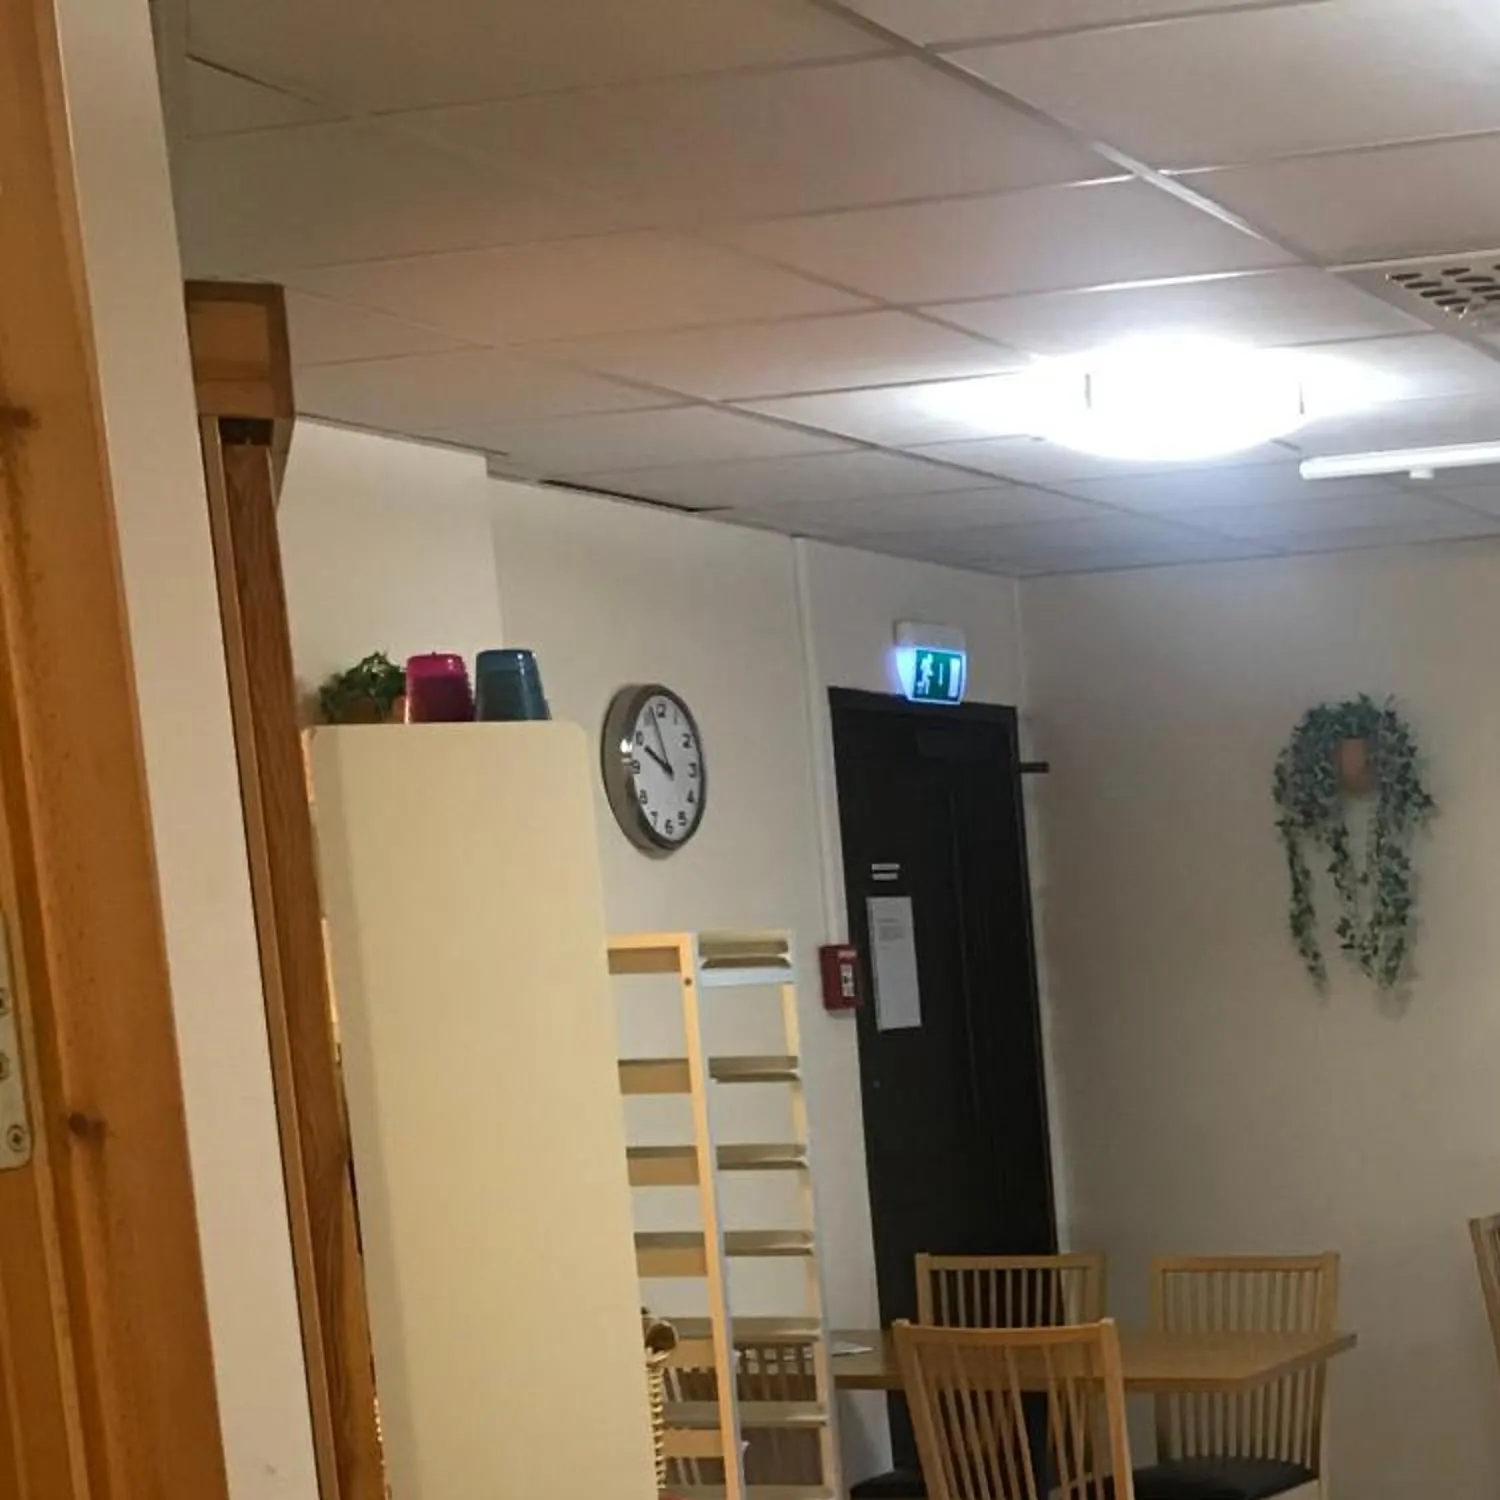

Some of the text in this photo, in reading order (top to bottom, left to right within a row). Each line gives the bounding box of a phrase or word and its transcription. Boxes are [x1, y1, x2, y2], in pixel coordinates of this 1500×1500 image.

[682, 732, 692, 749] 2
[688, 762, 697, 779] 3
[651, 811, 659, 828] 7
[665, 819, 674, 835] 6
